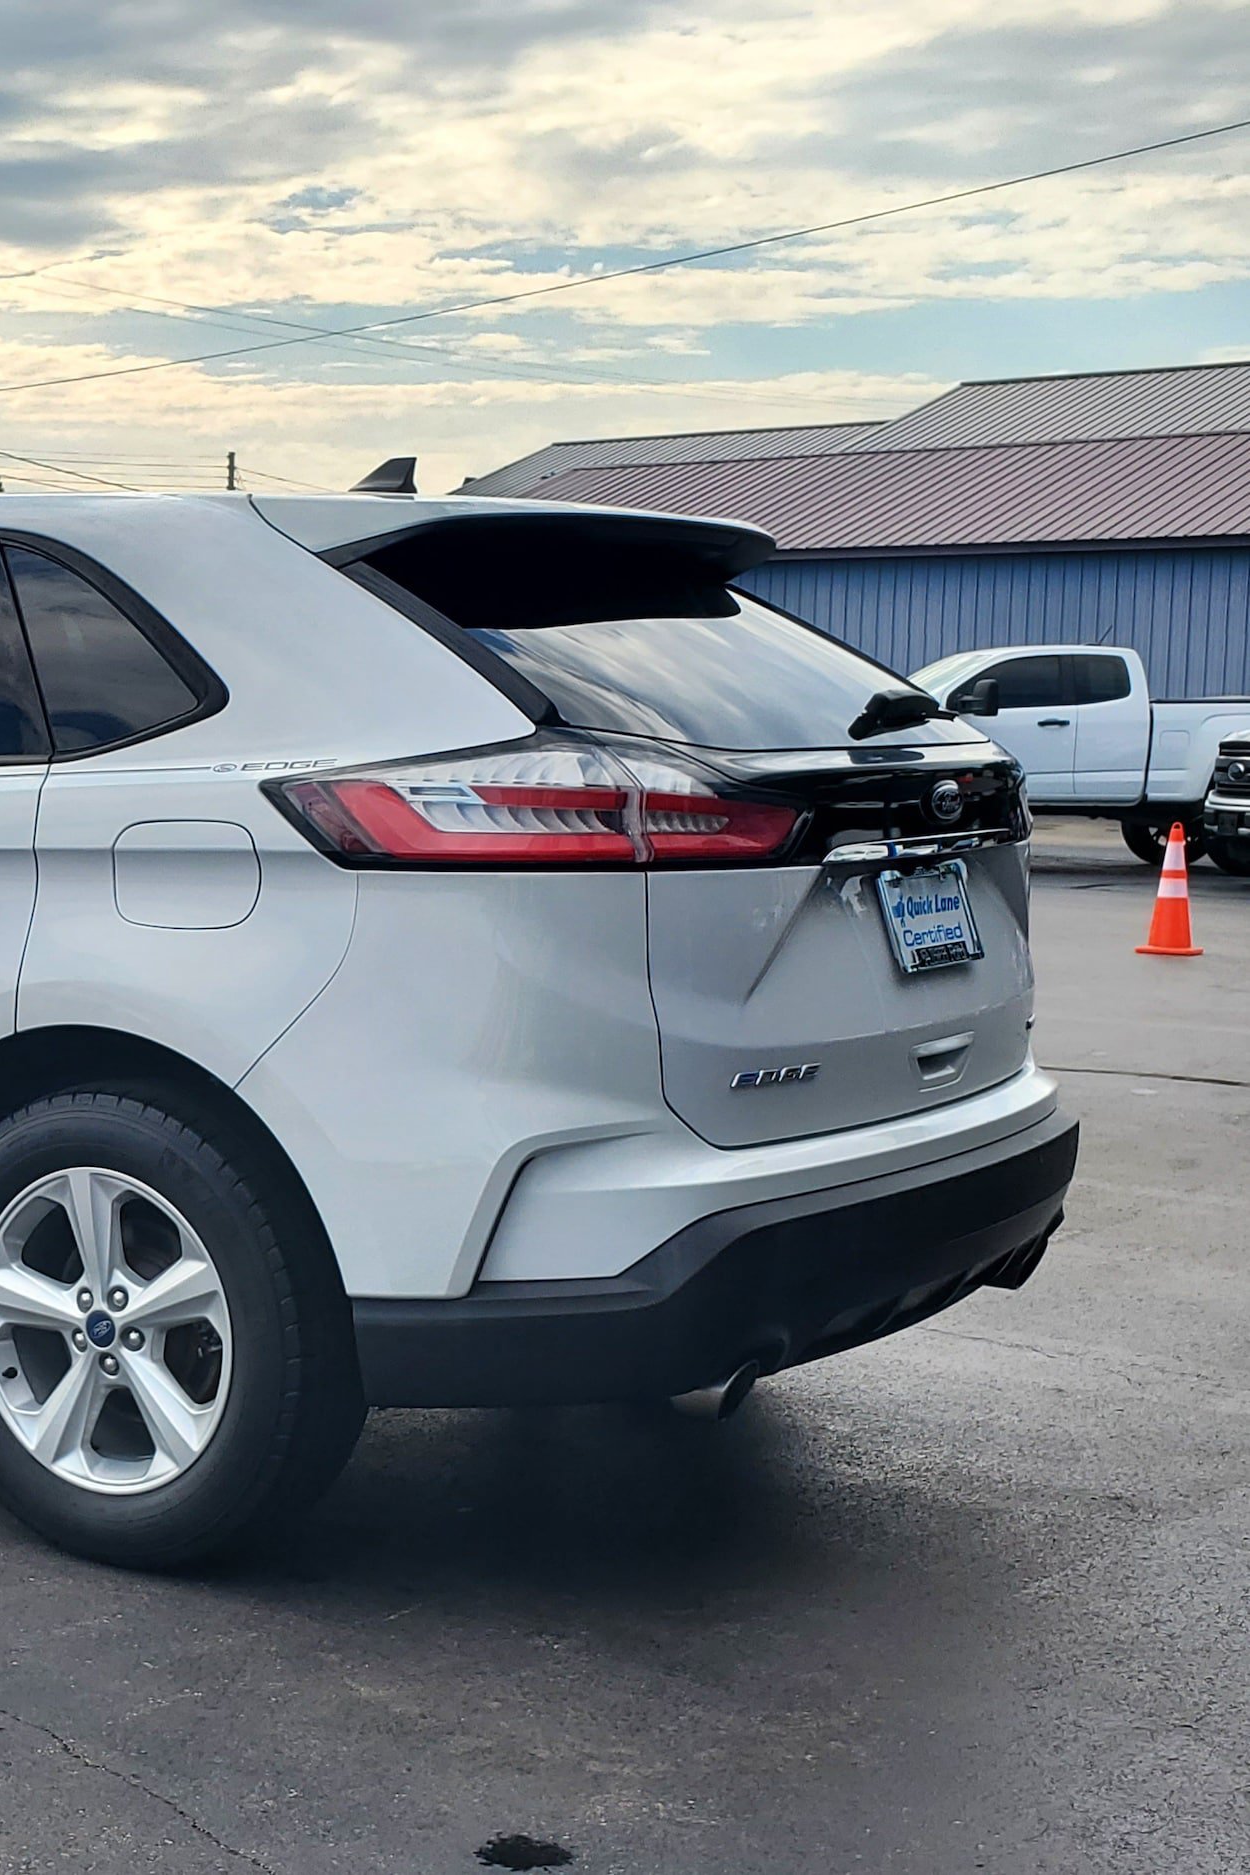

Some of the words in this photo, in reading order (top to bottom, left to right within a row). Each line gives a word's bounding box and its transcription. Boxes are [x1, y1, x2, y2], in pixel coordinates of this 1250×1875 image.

[240, 759, 338, 771] EDGE
[906, 895, 933, 919] Quick
[935, 894, 960, 913] Lane
[903, 922, 963, 947] Certified
[731, 1062, 822, 1088] EDGE
